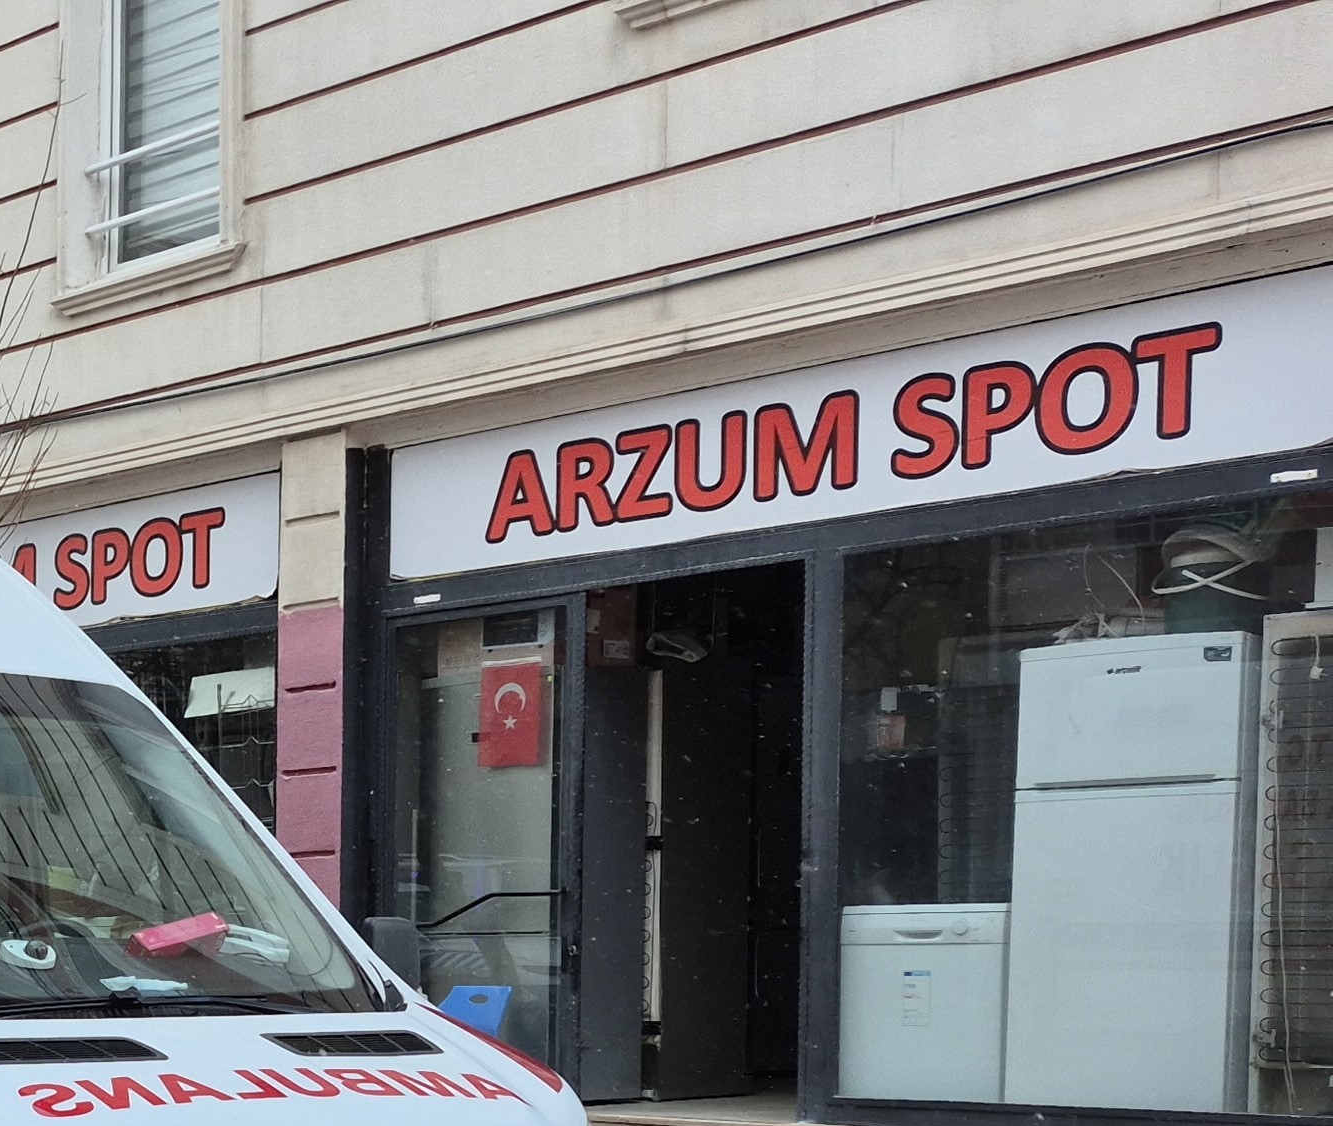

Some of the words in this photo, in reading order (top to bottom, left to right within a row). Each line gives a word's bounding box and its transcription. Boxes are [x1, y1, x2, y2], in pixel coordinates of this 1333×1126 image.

[485, 389, 859, 545] ARZUM
[890, 322, 1223, 477] SPOT
[53, 506, 226, 611] SPOT
